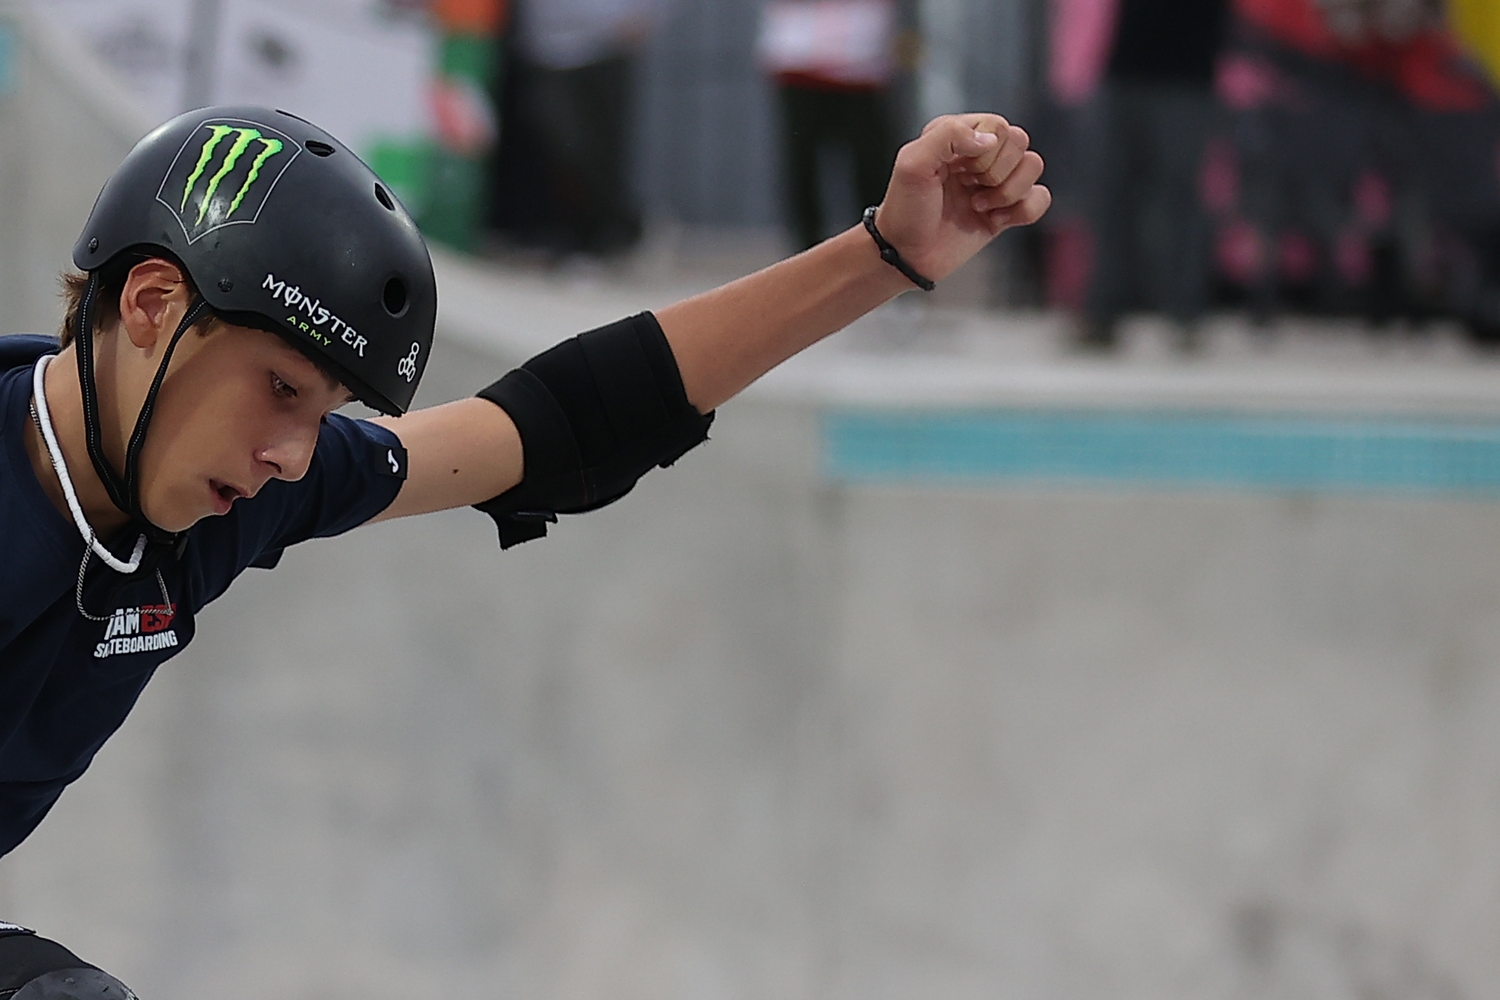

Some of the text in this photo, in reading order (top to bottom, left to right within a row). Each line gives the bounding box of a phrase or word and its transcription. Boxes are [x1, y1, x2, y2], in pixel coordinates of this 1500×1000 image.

[262, 274, 368, 357] MONSTER
[287, 315, 332, 346] ARMY
[94, 630, 178, 658] STEBOARDING
